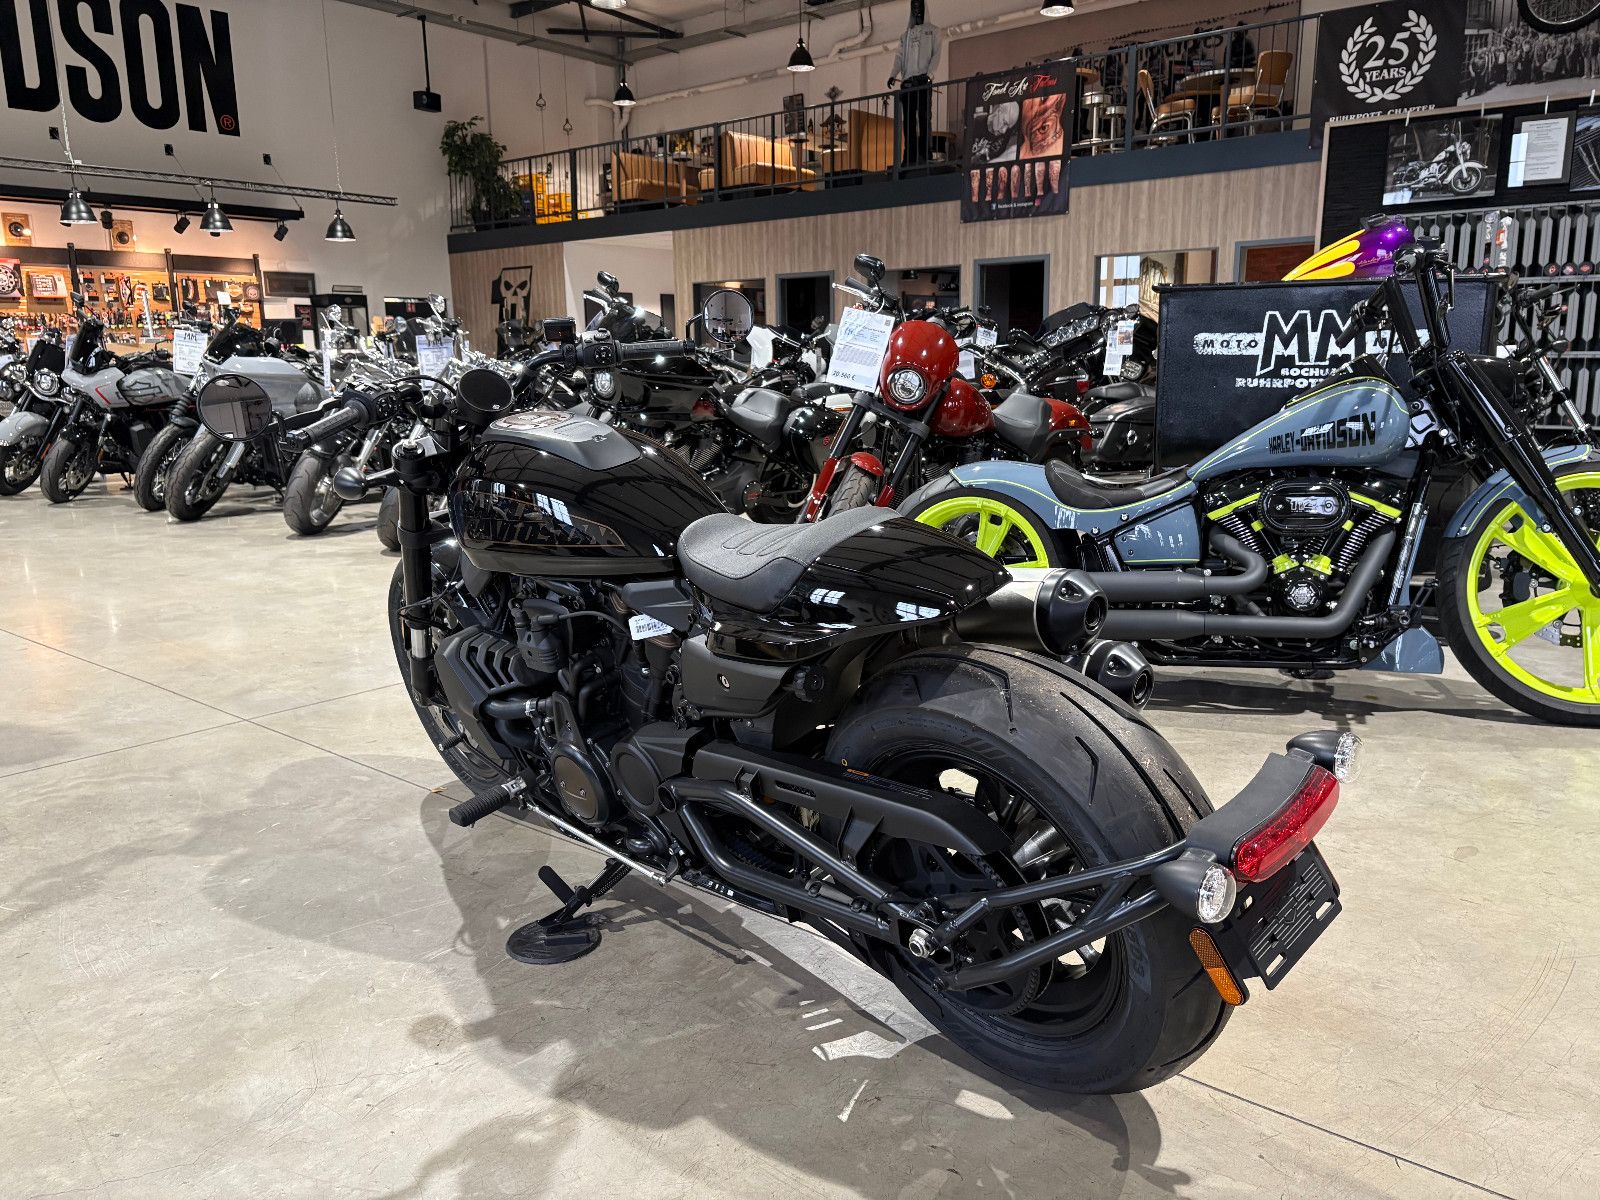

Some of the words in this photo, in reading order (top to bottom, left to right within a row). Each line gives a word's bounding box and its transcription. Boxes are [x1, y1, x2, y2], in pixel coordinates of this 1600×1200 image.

[1363, 31, 1411, 69] 25
[1364, 66, 1407, 83] YEARS
[1202, 340, 1259, 349] MOTO
[1235, 377, 1324, 389] RUHRPOT
